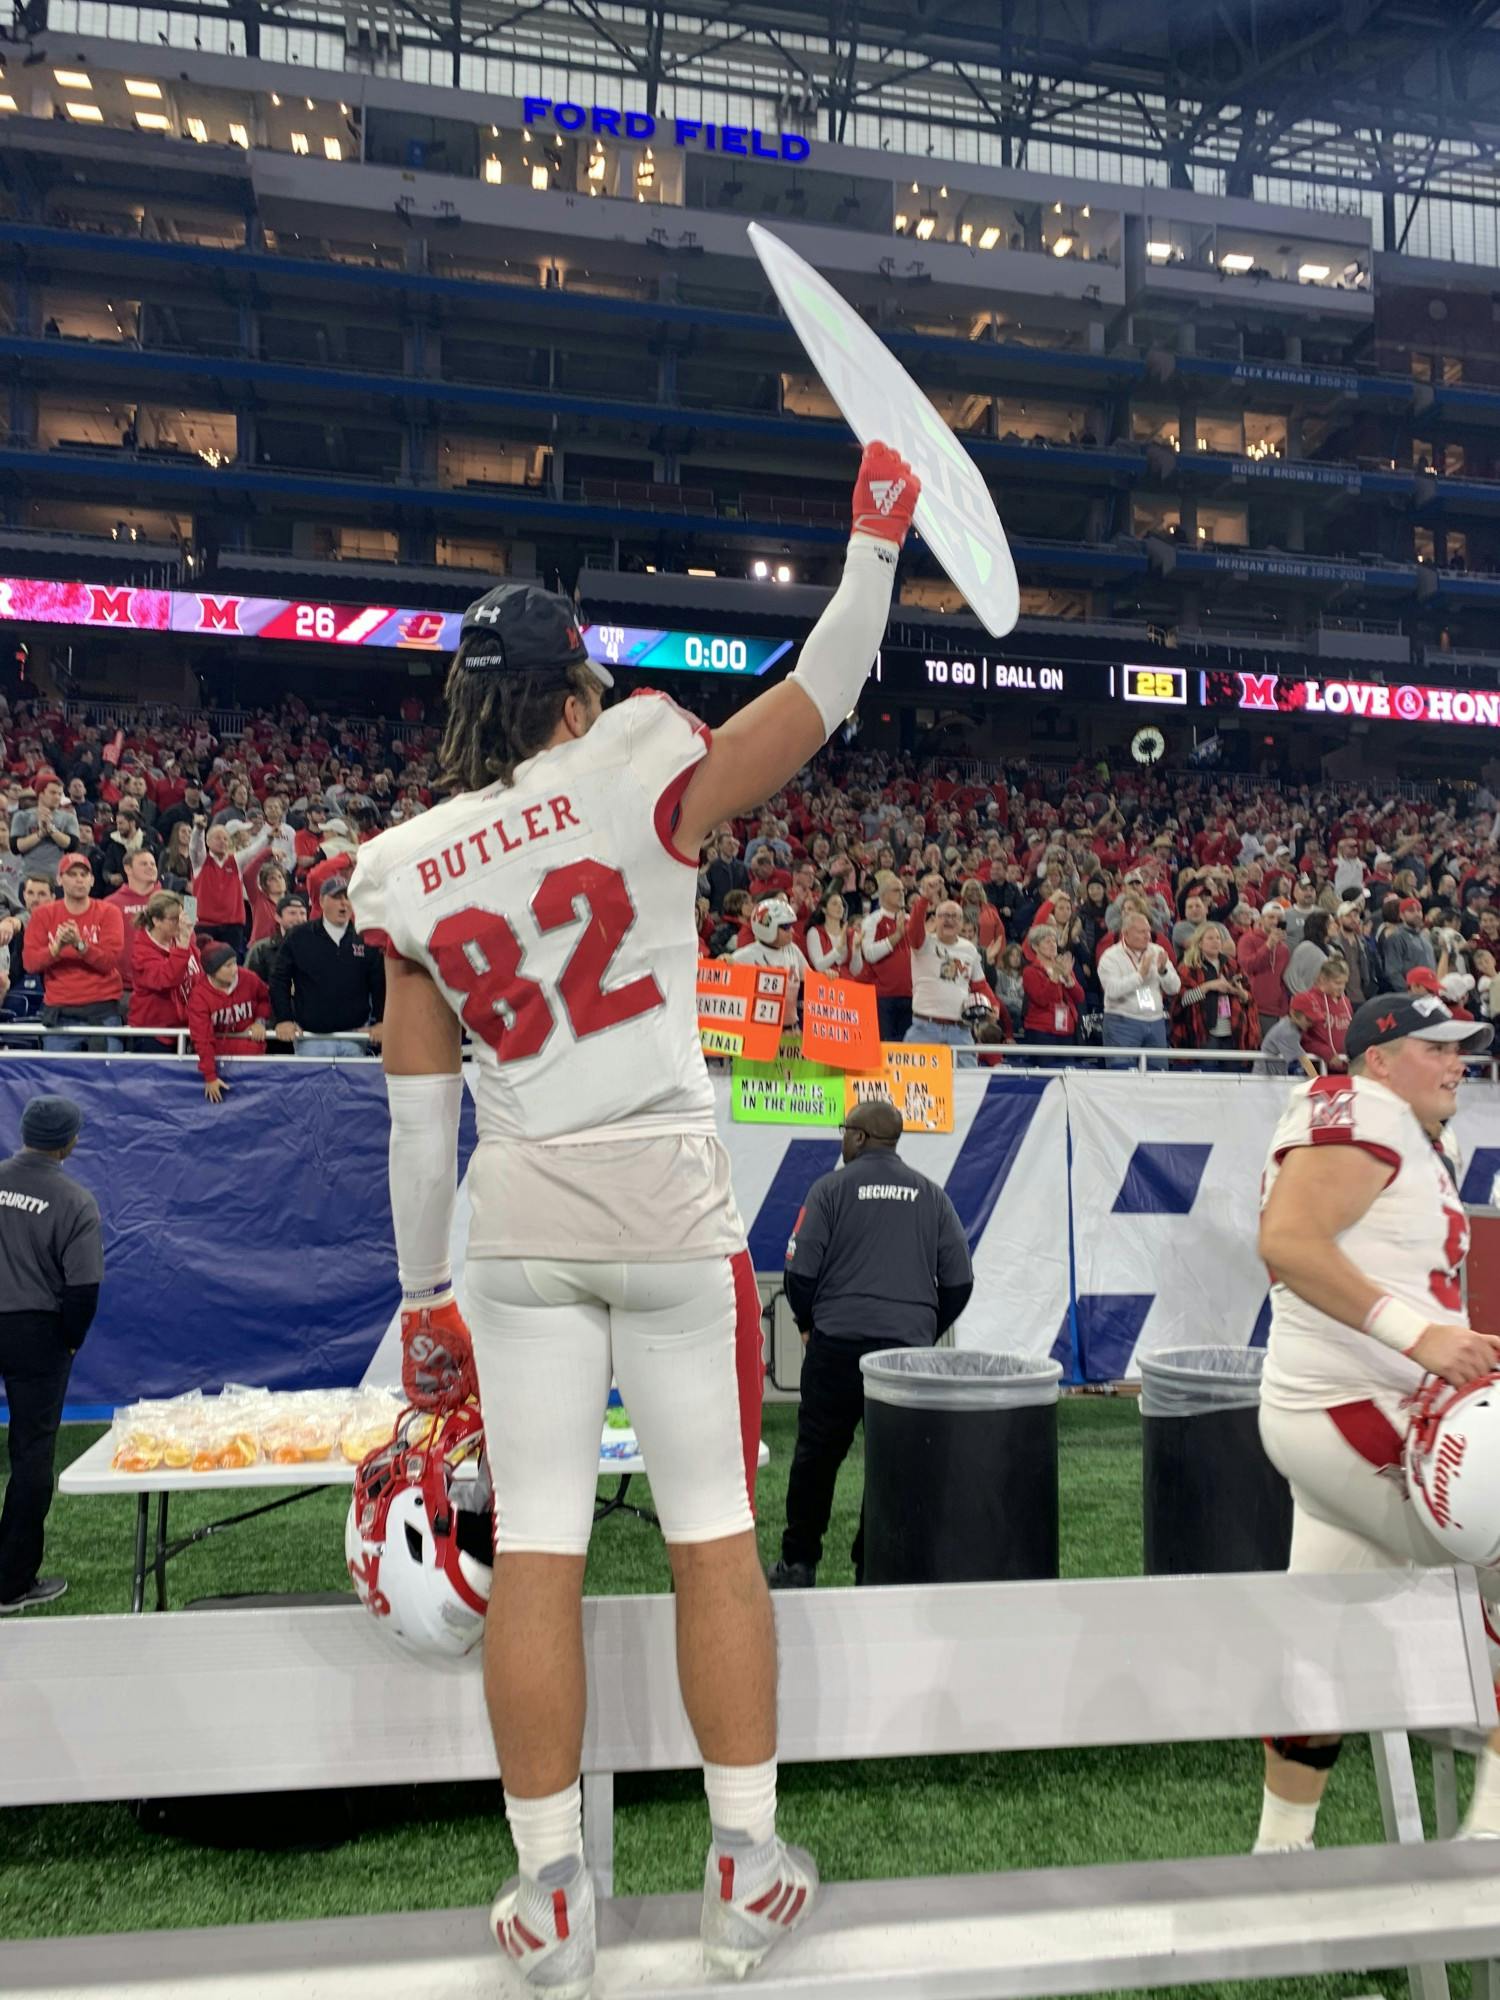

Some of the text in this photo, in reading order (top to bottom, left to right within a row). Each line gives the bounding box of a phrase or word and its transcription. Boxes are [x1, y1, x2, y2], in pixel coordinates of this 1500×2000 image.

[524, 97, 810, 161] FORD FIELD
[1234, 366, 1263, 378] ALEX
[1232, 463, 1270, 477] ROGER
[1273, 467, 1314, 481] BROWN
[1216, 558, 1265, 572] HERMAN
[1268, 562, 1308, 575] MOORE
[85, 584, 137, 627] M
[196, 593, 335, 638] M 26
[600, 626, 624, 644] QTR
[606, 641, 619, 662] 4
[685, 637, 747, 670] 0:00
[925, 660, 1063, 690] TO GO BALL ON
[1136, 672, 1174, 697] 25
[1238, 673, 1279, 710] M
[1305, 681, 1390, 715] LOVE
[416, 795, 581, 895] BUTLER
[427, 858, 667, 1065] 82
[763, 977, 778, 990] 26
[818, 986, 845, 1004] MAC
[696, 998, 774, 1019] ENTRAL 21
[702, 1031, 739, 1053] FINAL
[813, 1024, 850, 1042] AGAIN
[742, 1079, 823, 1098] MIAMI FAN IS
[853, 1080, 888, 1093] MIAMI
[743, 1095, 756, 1109] IN
[765, 1097, 785, 1112] THE
[790, 1099, 825, 1115] HOUSE
[1308, 1089, 1358, 1129] M
[858, 1185, 919, 1202] SECURITY
